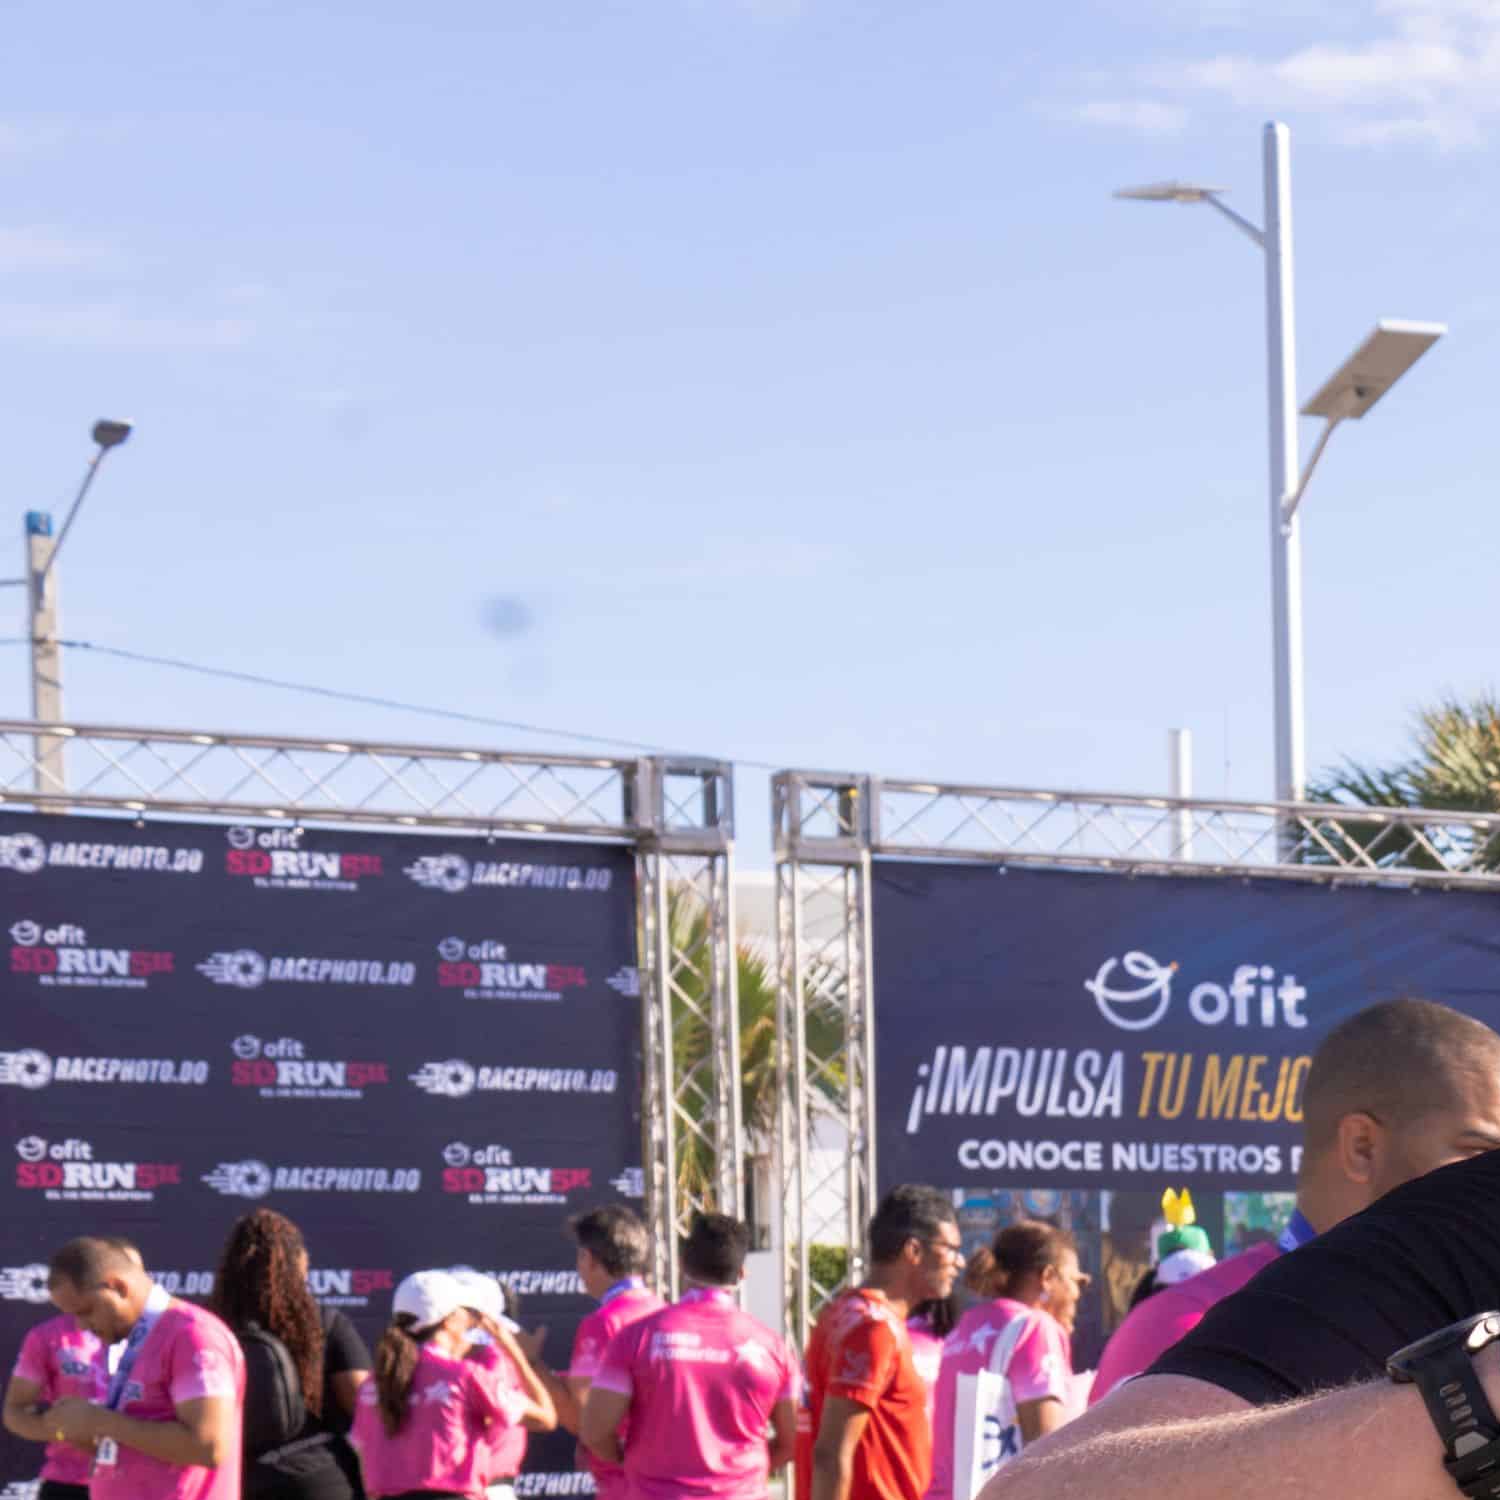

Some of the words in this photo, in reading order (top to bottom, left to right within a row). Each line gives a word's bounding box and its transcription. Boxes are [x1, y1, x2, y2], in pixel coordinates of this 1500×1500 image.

[48, 842, 204, 873] RACEPHOTO.DO
[43, 923, 86, 946] ofit
[467, 939, 506, 960] ofit
[268, 957, 416, 986] RACEPHOTO.DO
[1188, 965, 1308, 1027] ofit
[263, 1036, 305, 1058] ofit
[54, 1057, 209, 1085] RACEPHOTO.DO
[477, 1067, 618, 1093] RACEPHOTO.DO
[906, 1046, 1124, 1135] ¡IMPULSA
[1135, 1051, 1193, 1121] TU
[1198, 1055, 1312, 1122] MEJO
[49, 1138, 93, 1160] ofit
[471, 1145, 512, 1165] ofit
[959, 1139, 1102, 1171] CONOCE
[1112, 1144, 1282, 1175] NUESTROS
[272, 1167, 420, 1192] RACEPHOTO.DO
